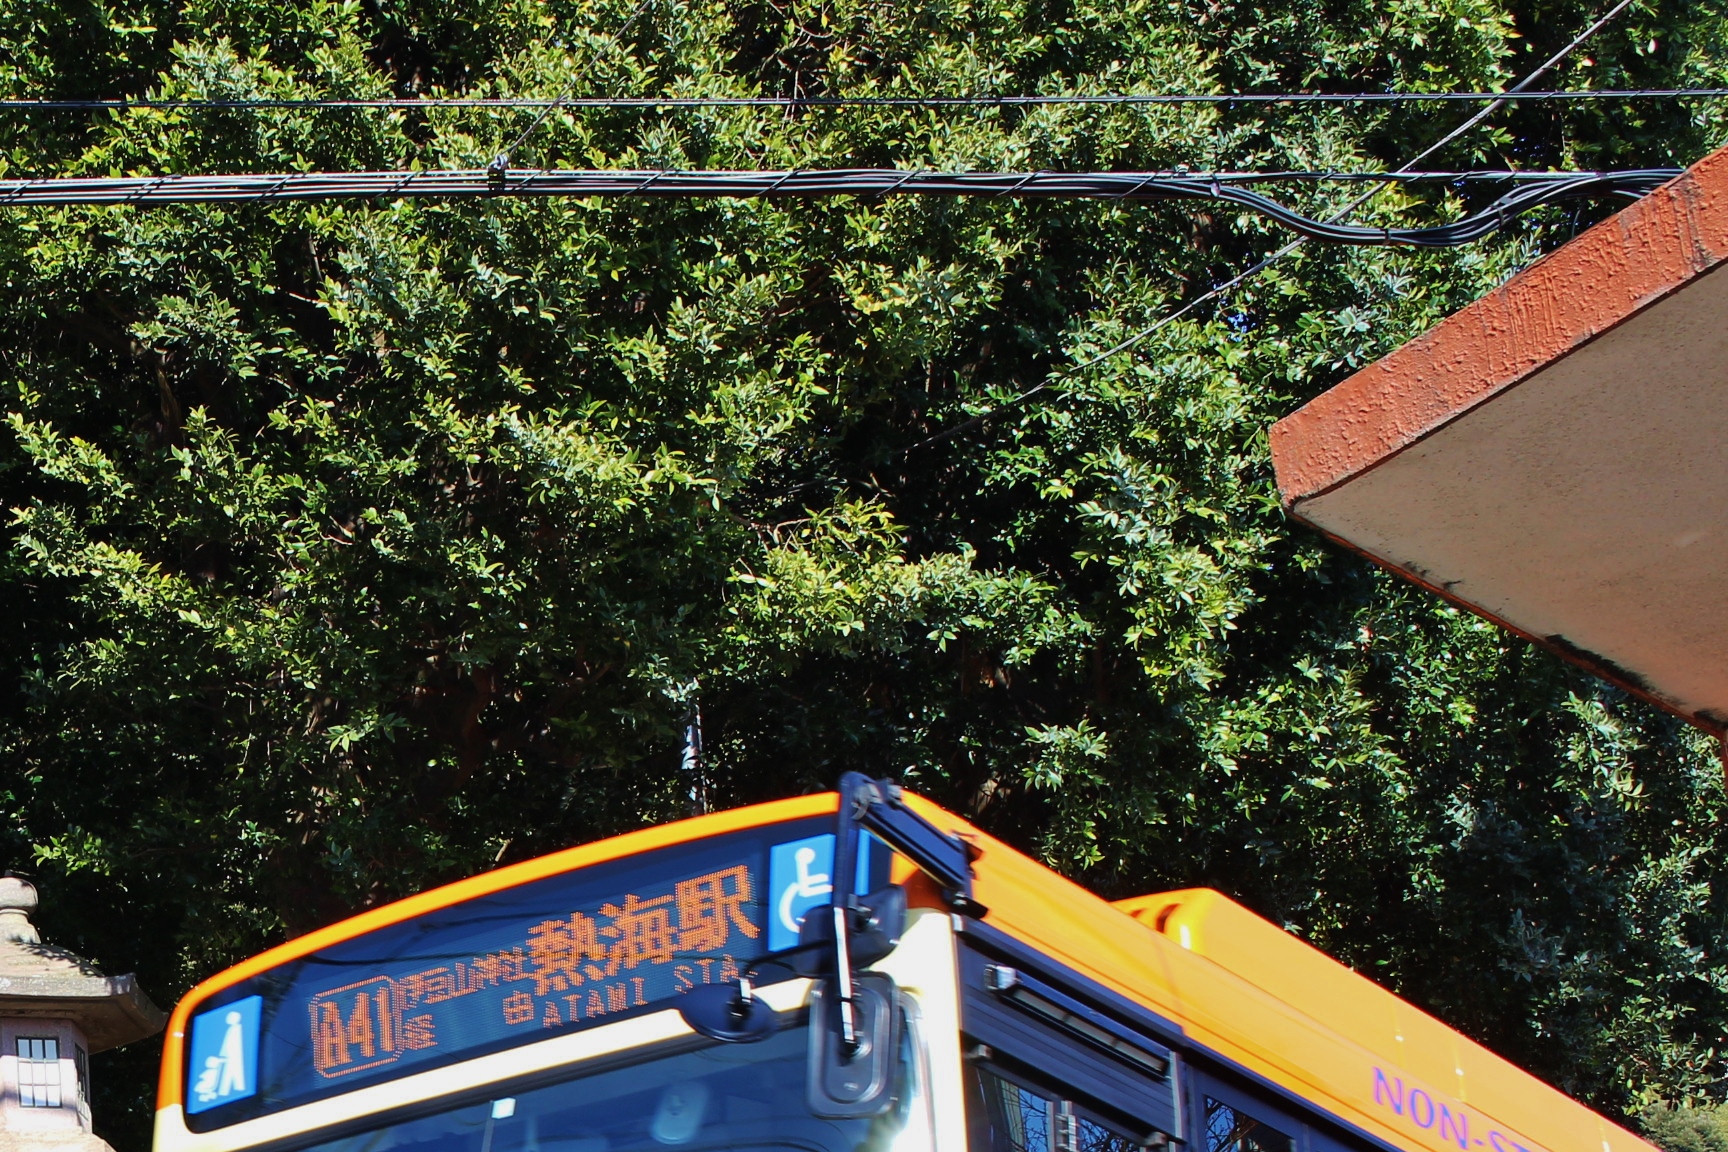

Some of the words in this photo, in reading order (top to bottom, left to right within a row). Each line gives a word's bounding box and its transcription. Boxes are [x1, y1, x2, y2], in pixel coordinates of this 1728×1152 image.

[526, 864, 760, 996] 熱海駅
[318, 985, 395, 1069] A41
[543, 976, 648, 1029] ATAMI
